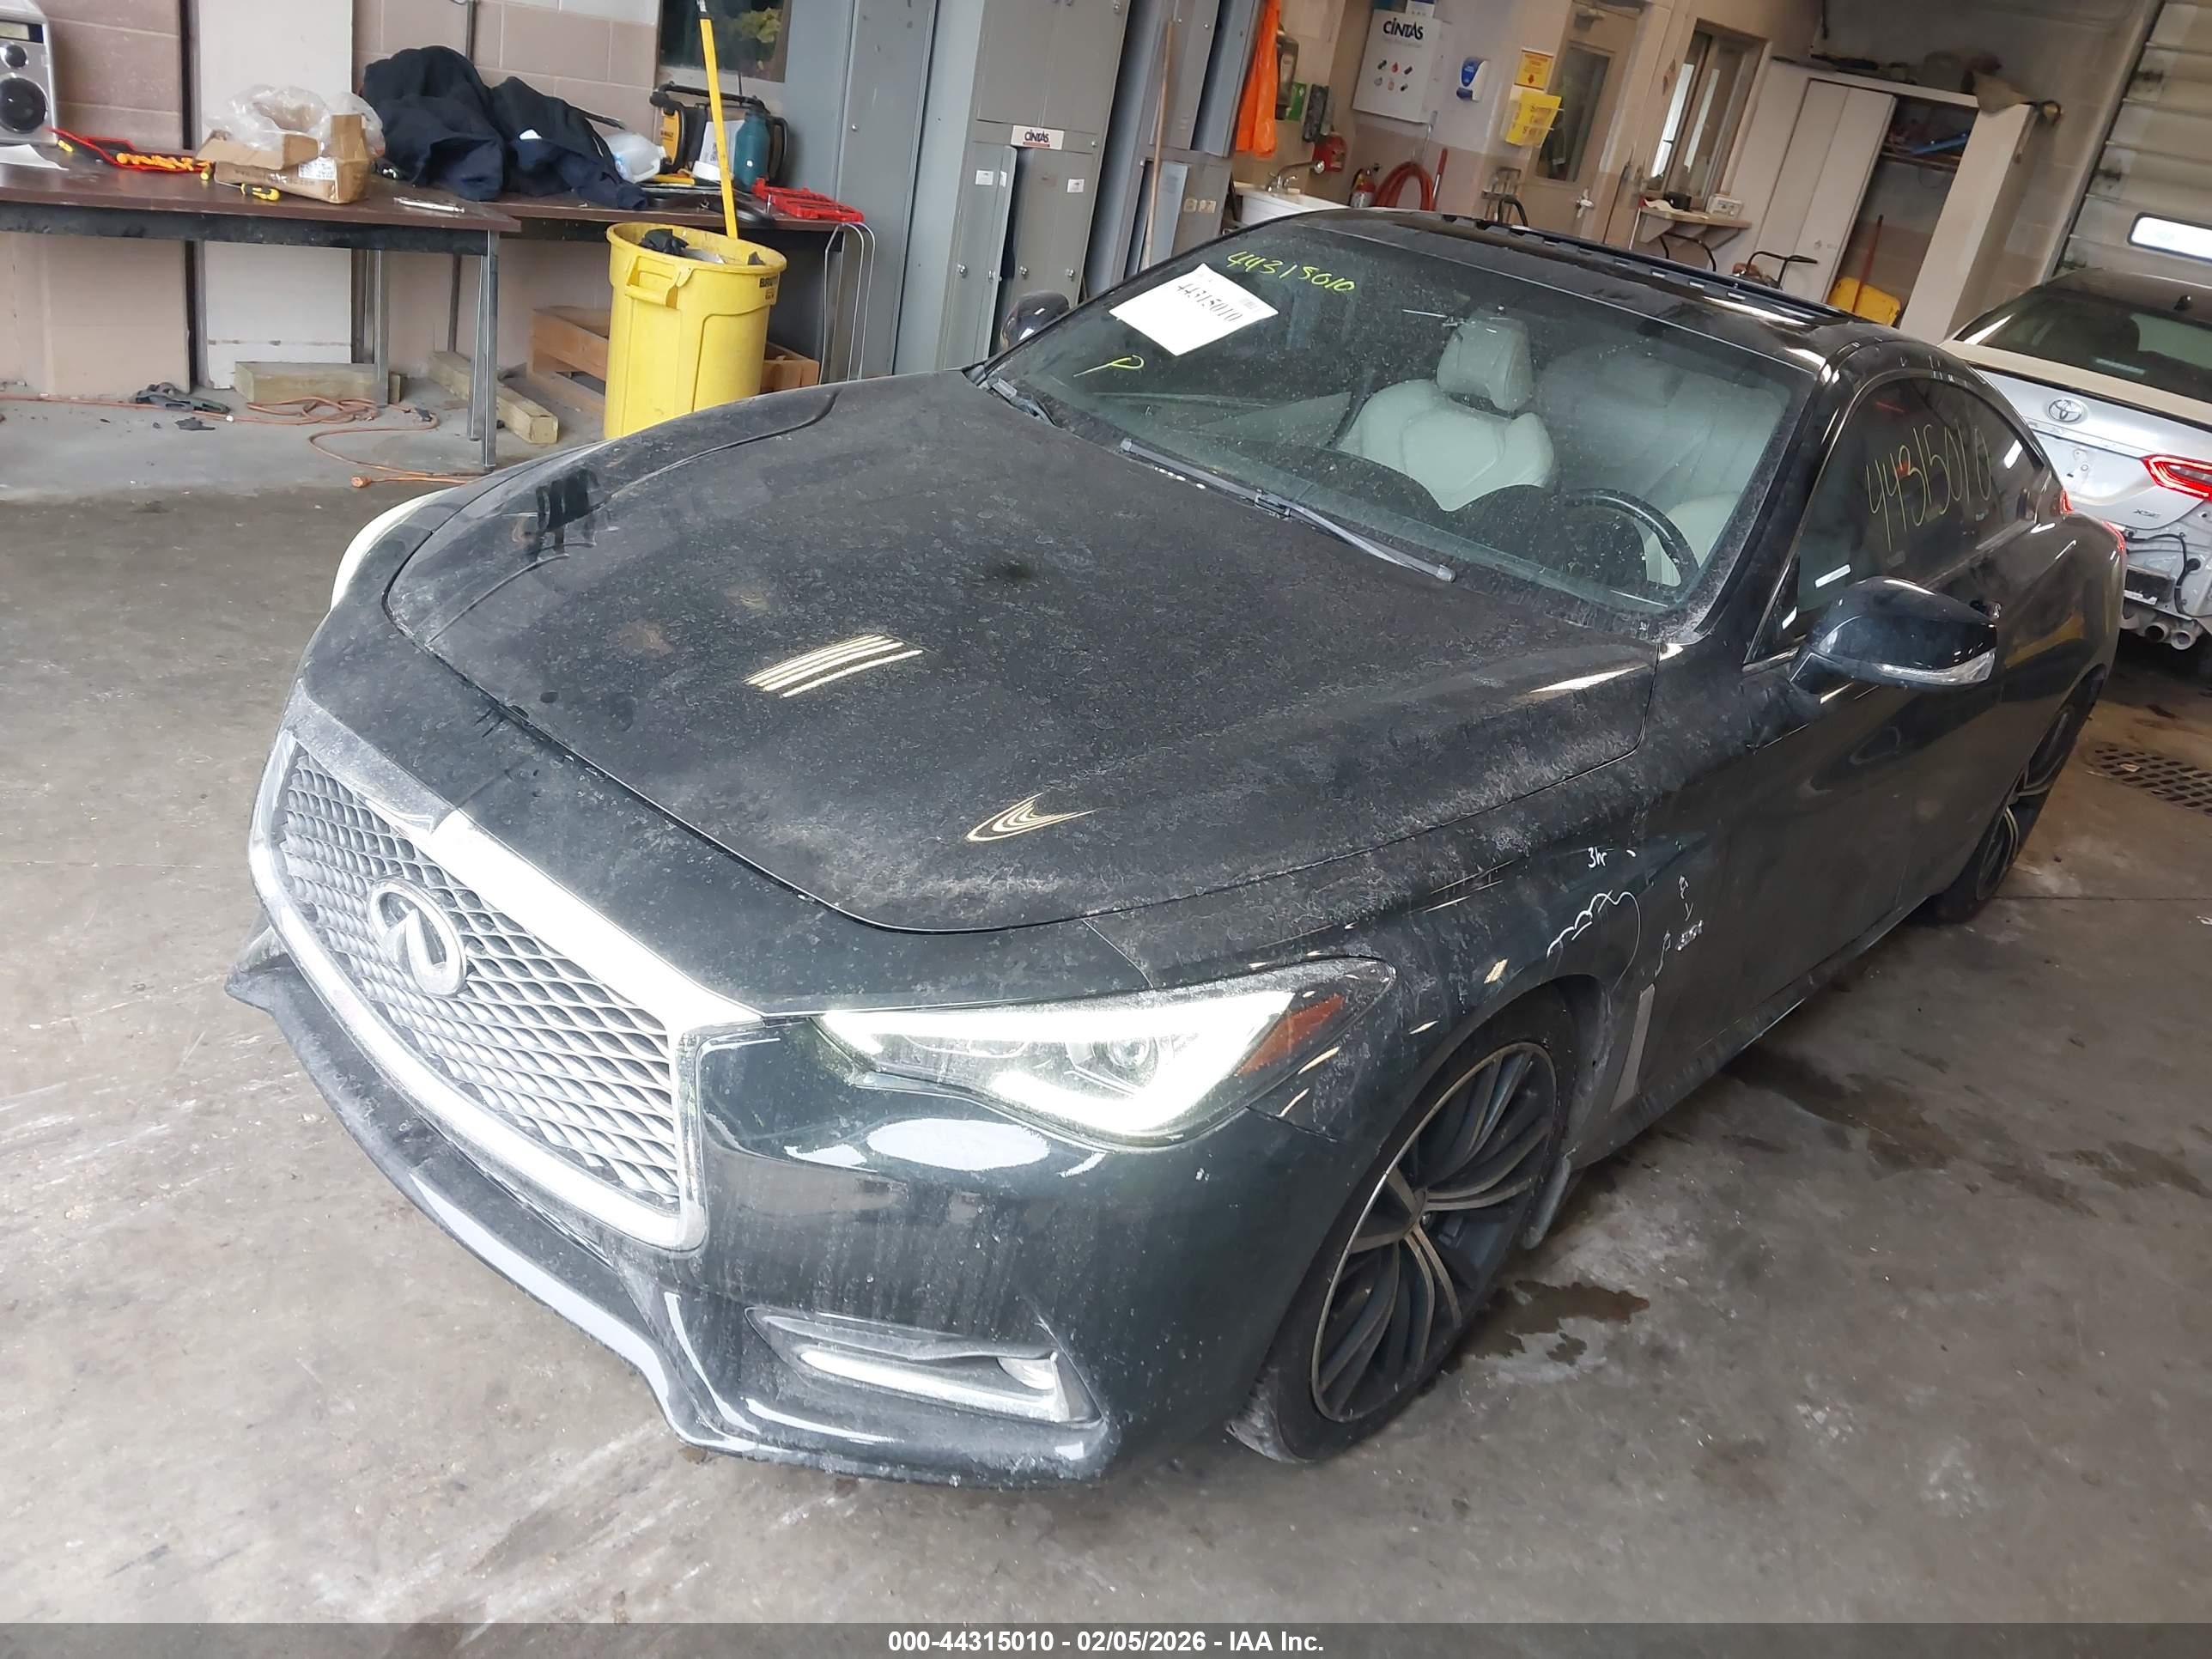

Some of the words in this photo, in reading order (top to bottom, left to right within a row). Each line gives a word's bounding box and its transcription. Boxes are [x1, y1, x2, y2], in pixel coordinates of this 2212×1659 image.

[1382, 17, 1424, 40] CINTAS
[1227, 251, 1355, 292] 44315010
[1176, 283, 1243, 322] 44315010
[1866, 419, 1992, 550] 44315010
